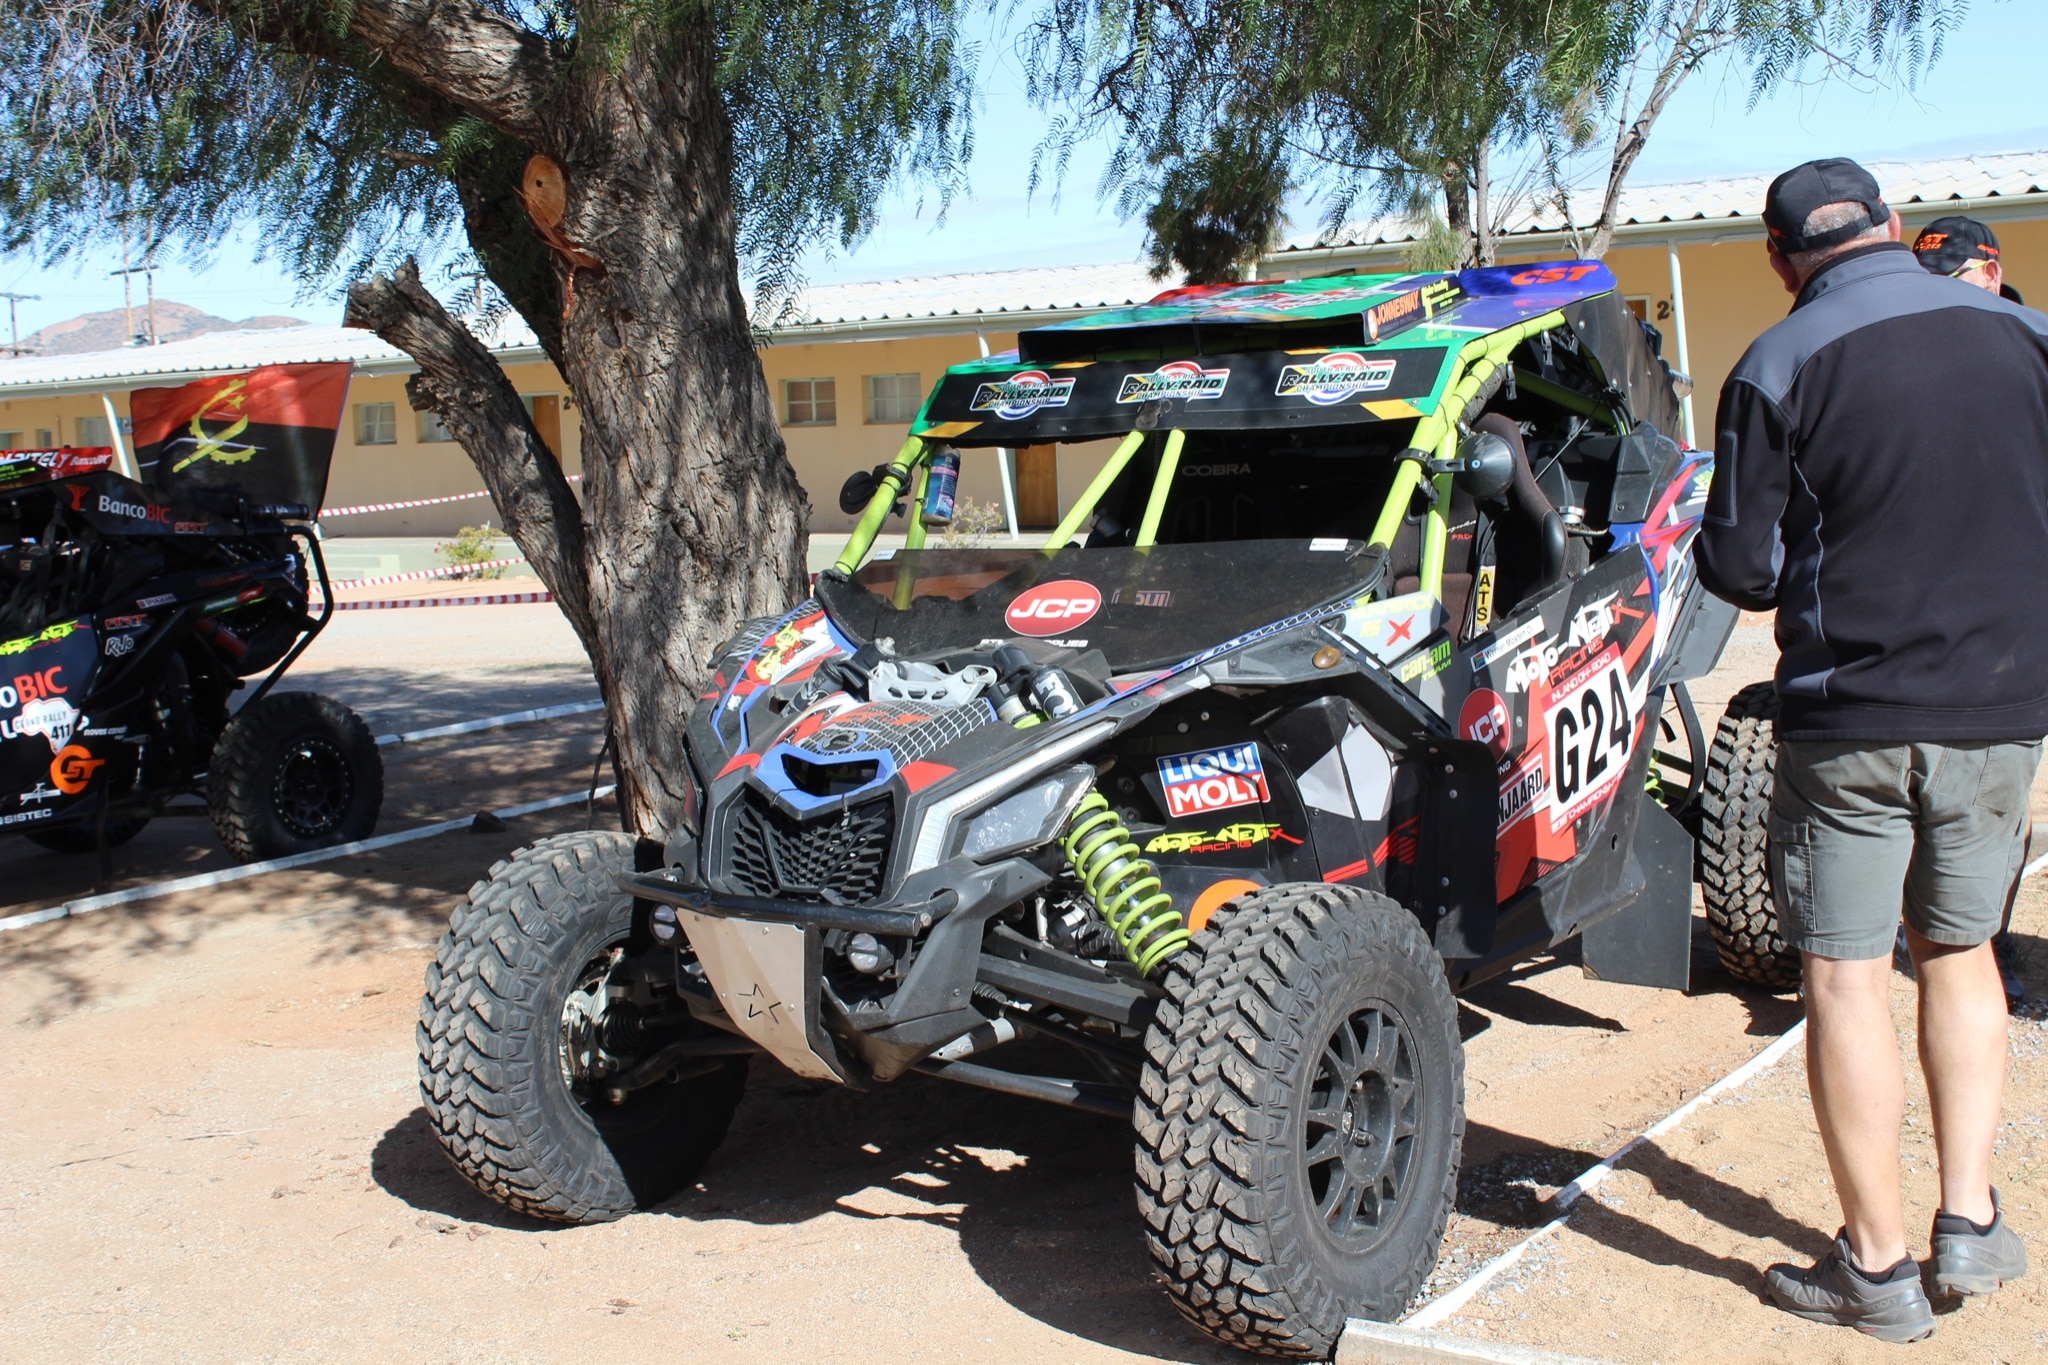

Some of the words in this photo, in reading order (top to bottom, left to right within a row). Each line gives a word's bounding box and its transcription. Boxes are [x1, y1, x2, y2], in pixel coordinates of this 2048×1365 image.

[1919, 233, 1949, 244] ST
[1510, 265, 1599, 286] CST
[1377, 290, 1419, 325] JONNESWAY
[1171, 372, 1207, 380] AFRICAN
[1334, 364, 1371, 372] AFRICAN
[1021, 381, 1055, 390] AFRICAN
[1122, 379, 1222, 395] RALLY-RAID
[1281, 370, 1388, 387] RALLY-RAID
[1296, 381, 1369, 393] CHAMPIONSHIP
[976, 386, 1068, 403] RALLY-RAID
[988, 397, 1051, 409] CHAMPIONSHIP
[1135, 389, 1204, 400] CHAMPIONSHIP
[1182, 463, 1251, 477] COBRA
[98, 495, 171, 525] BancoBIC
[1477, 573, 1491, 621] ATS
[1010, 598, 1096, 618] JCP
[1400, 640, 1451, 683] can-am
[1550, 635, 1604, 686] RACING
[1422, 659, 1452, 681] TEAM
[51, 723, 71, 741] 411
[1555, 668, 1631, 804] G24
[1163, 746, 1257, 783] LIQUI
[1170, 774, 1262, 813] MOLY
[1190, 840, 1253, 854] RACING
